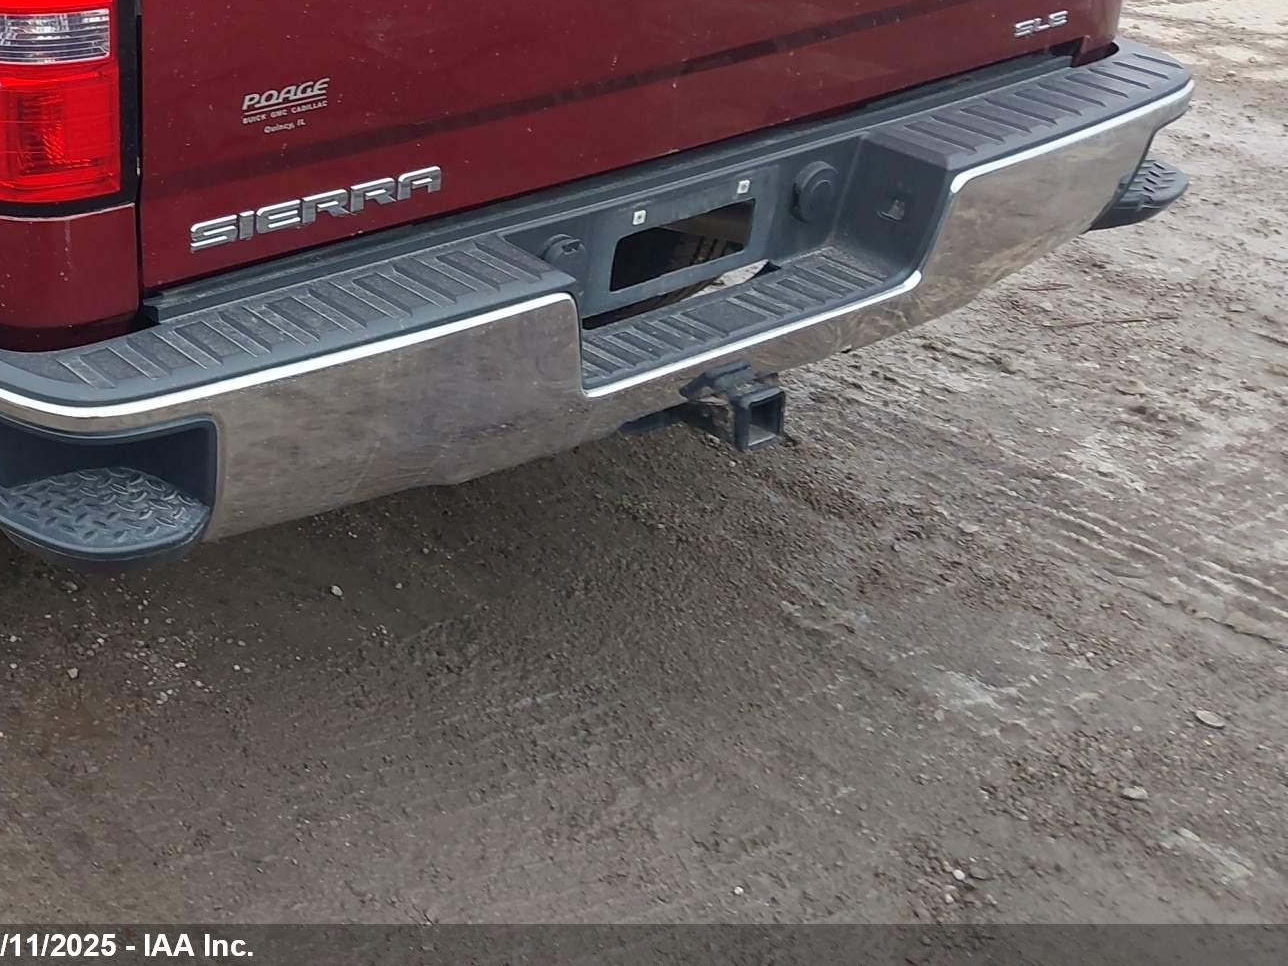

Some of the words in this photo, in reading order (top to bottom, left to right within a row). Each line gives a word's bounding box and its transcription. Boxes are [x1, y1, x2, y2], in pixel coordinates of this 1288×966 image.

[242, 77, 330, 110] POAGE
[291, 100, 328, 113] CADILLAC
[190, 166, 441, 253] SIERRA
